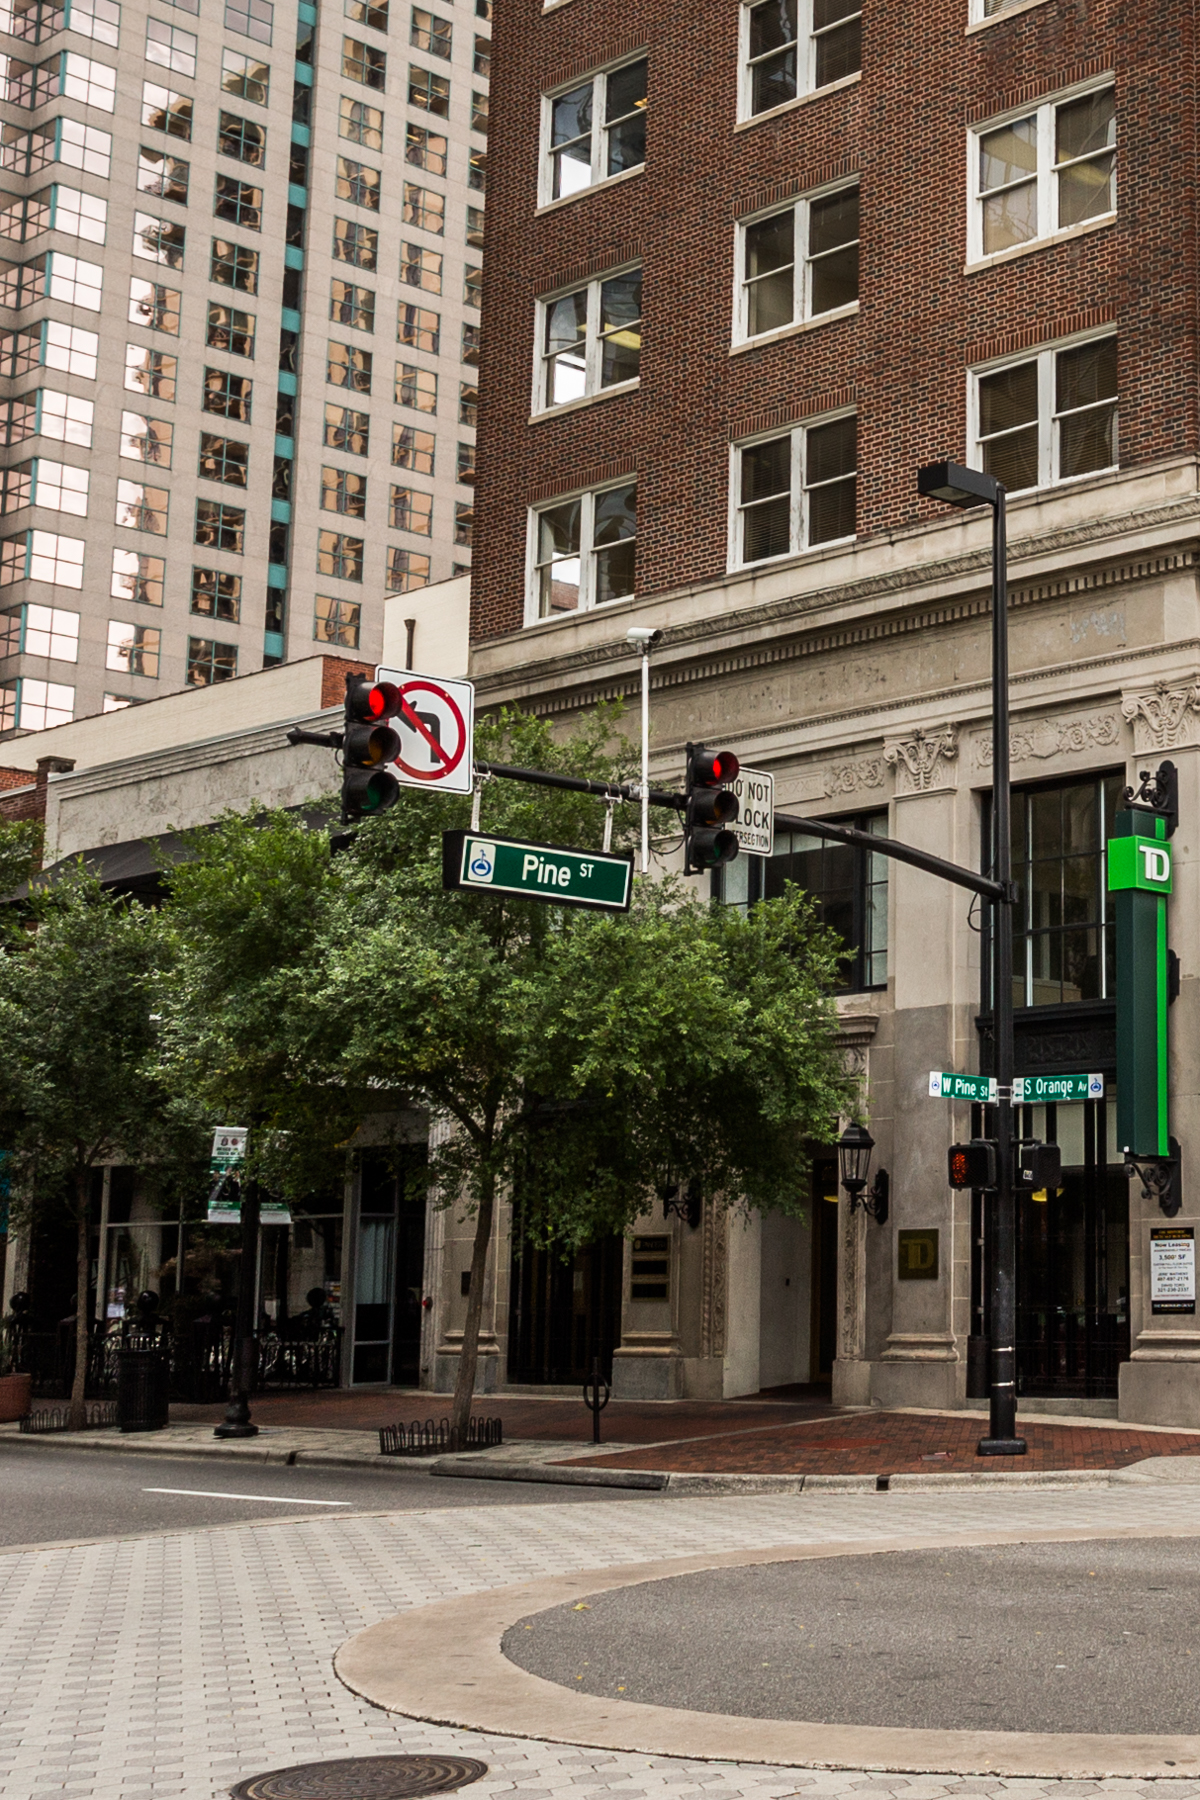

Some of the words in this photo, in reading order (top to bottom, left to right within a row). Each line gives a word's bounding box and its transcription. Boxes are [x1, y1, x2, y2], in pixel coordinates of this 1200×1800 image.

[748, 782, 769, 802] NOT
[736, 808, 769, 830] LOCK
[522, 854, 571, 887] Pine
[579, 863, 595, 878] ST
[1139, 845, 1170, 882] TD
[942, 1077, 952, 1093] W
[955, 1077, 976, 1096] Pine
[980, 1085, 988, 1097] St
[1024, 1080, 1032, 1095] S
[1036, 1078, 1073, 1097] Orange
[1078, 1082, 1087, 1092] Av
[902, 1239, 934, 1269] TD
